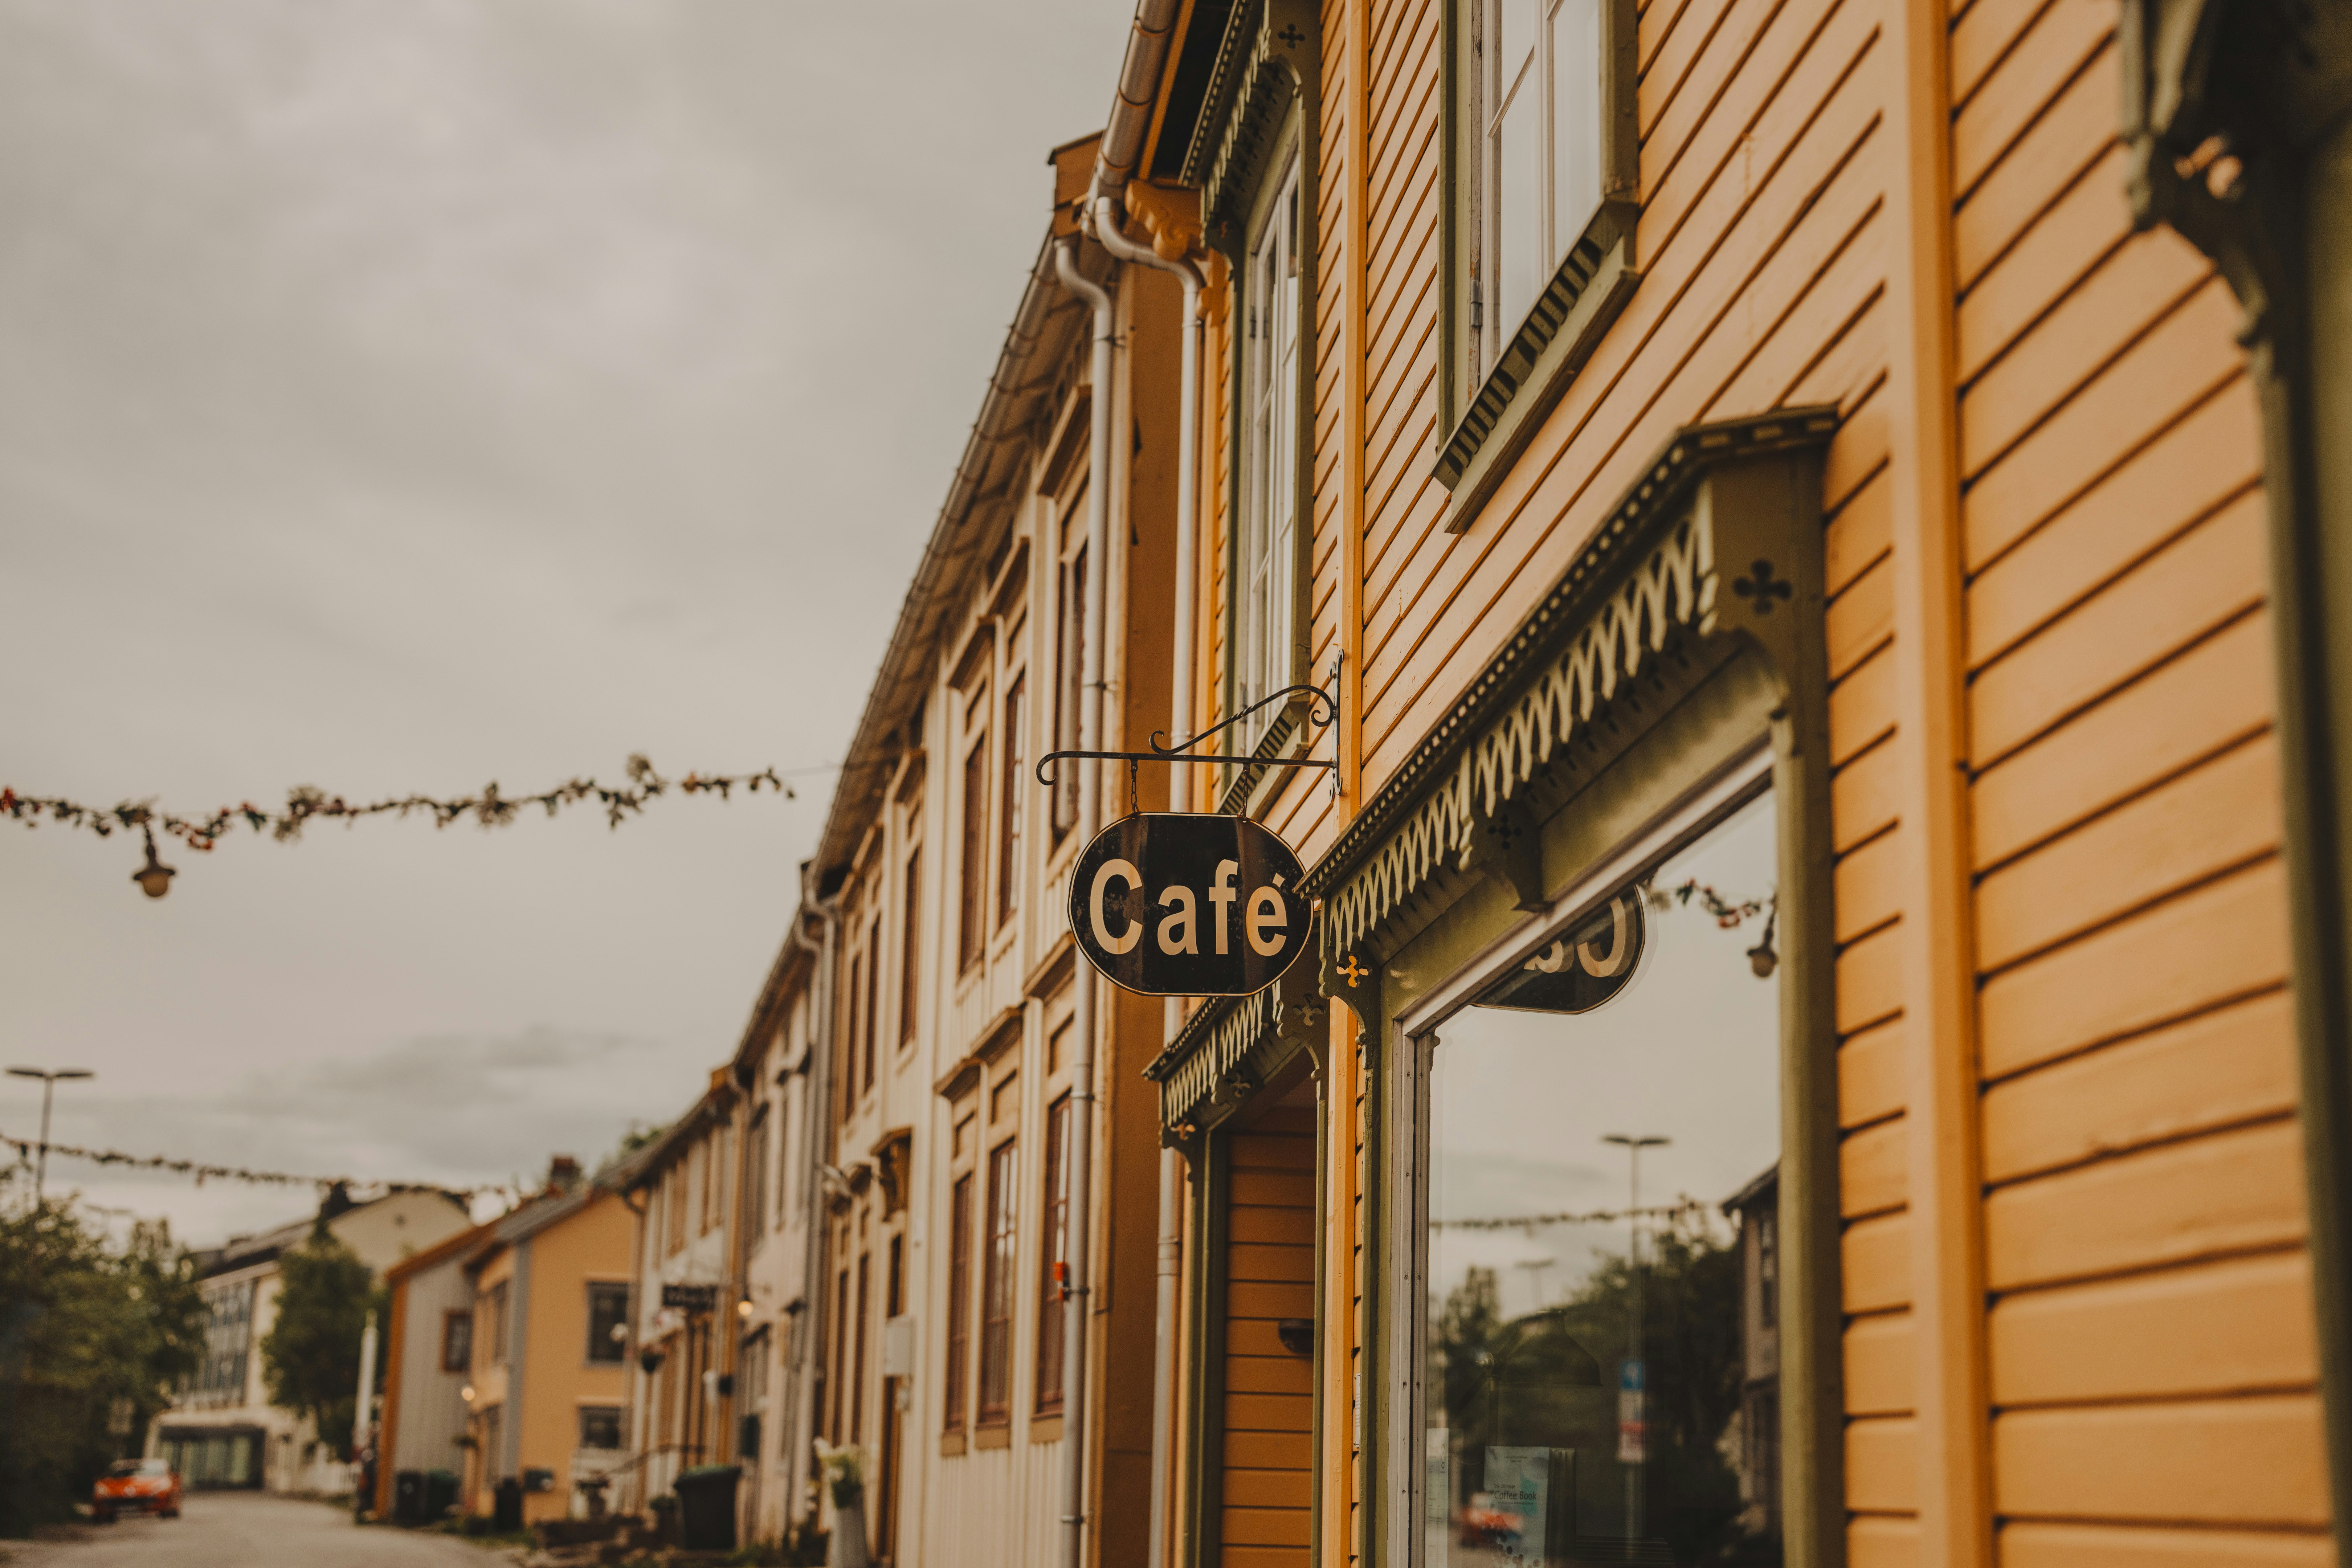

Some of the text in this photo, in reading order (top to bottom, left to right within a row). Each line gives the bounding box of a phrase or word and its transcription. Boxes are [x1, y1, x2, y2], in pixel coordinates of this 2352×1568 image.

[1090, 858, 1287, 956] Café
[1494, 1490, 1536, 1500] Coffee Book
